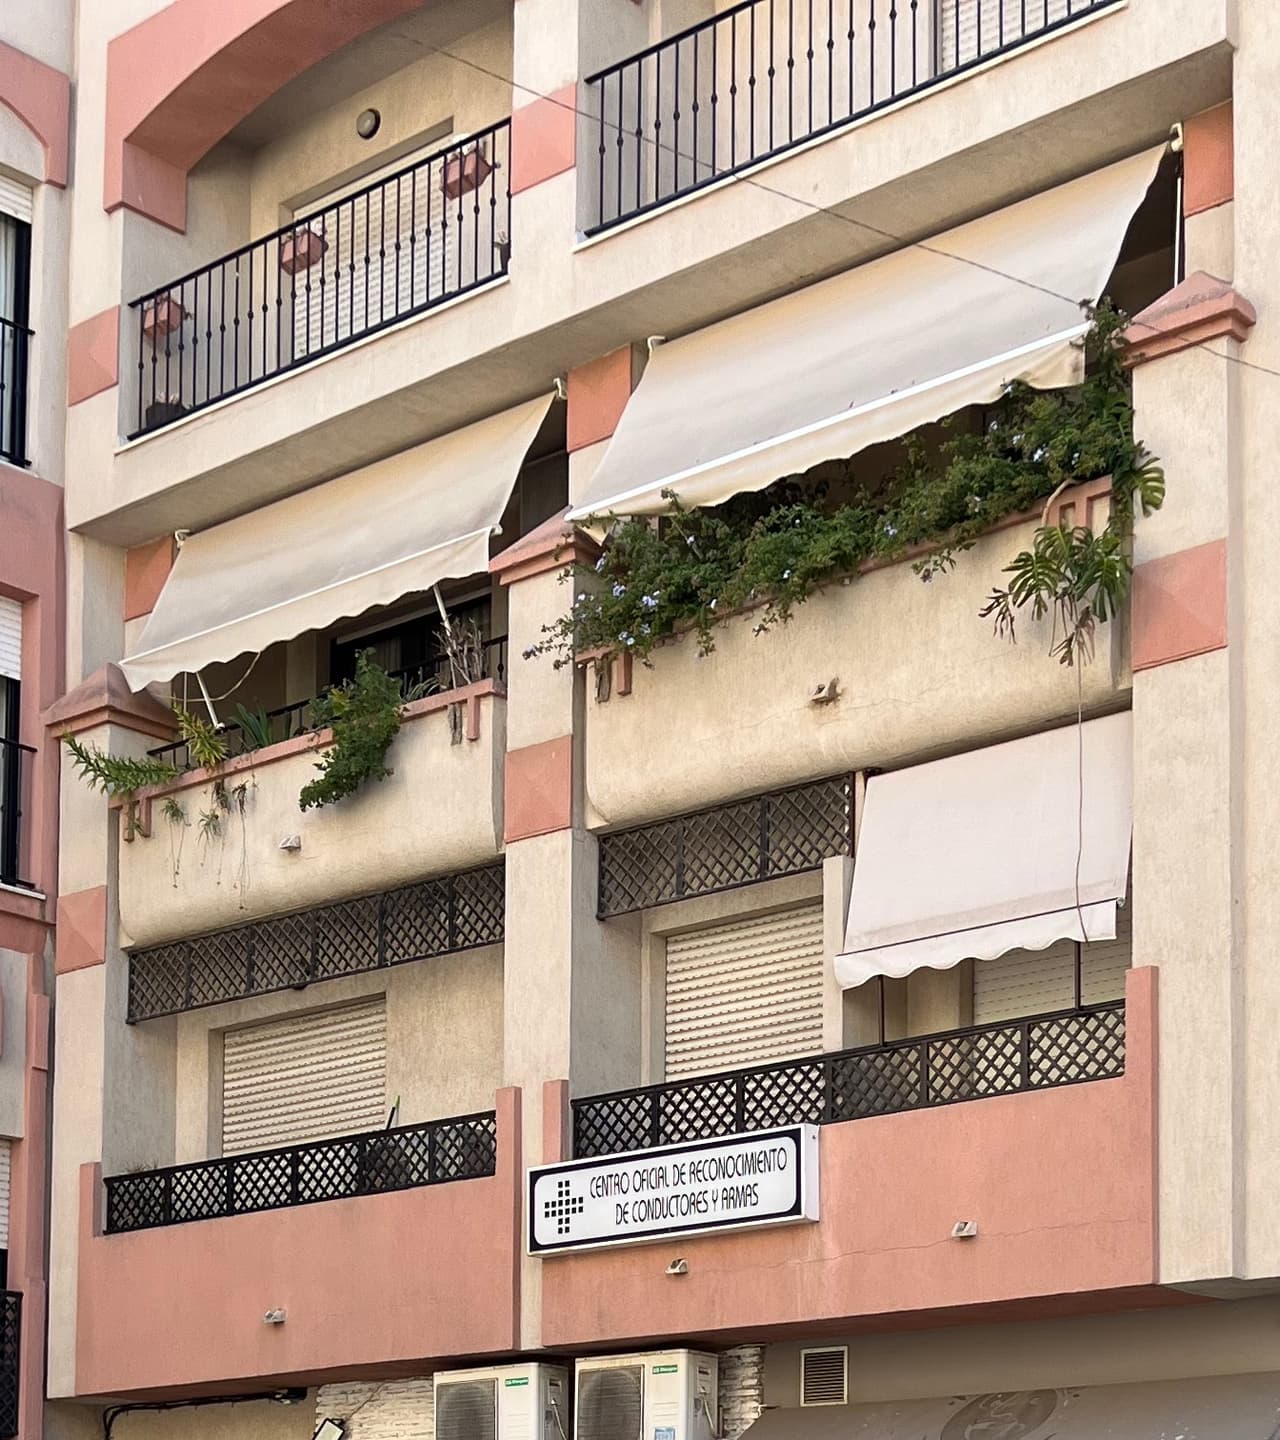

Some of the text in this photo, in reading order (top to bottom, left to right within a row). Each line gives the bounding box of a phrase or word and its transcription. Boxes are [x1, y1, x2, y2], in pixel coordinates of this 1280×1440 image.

[590, 1147, 788, 1199] CENTRO OFICIAL DE RECONOCIMIENTO
[616, 1182, 759, 1225] DE CONDUCTORES Y ARMAS
